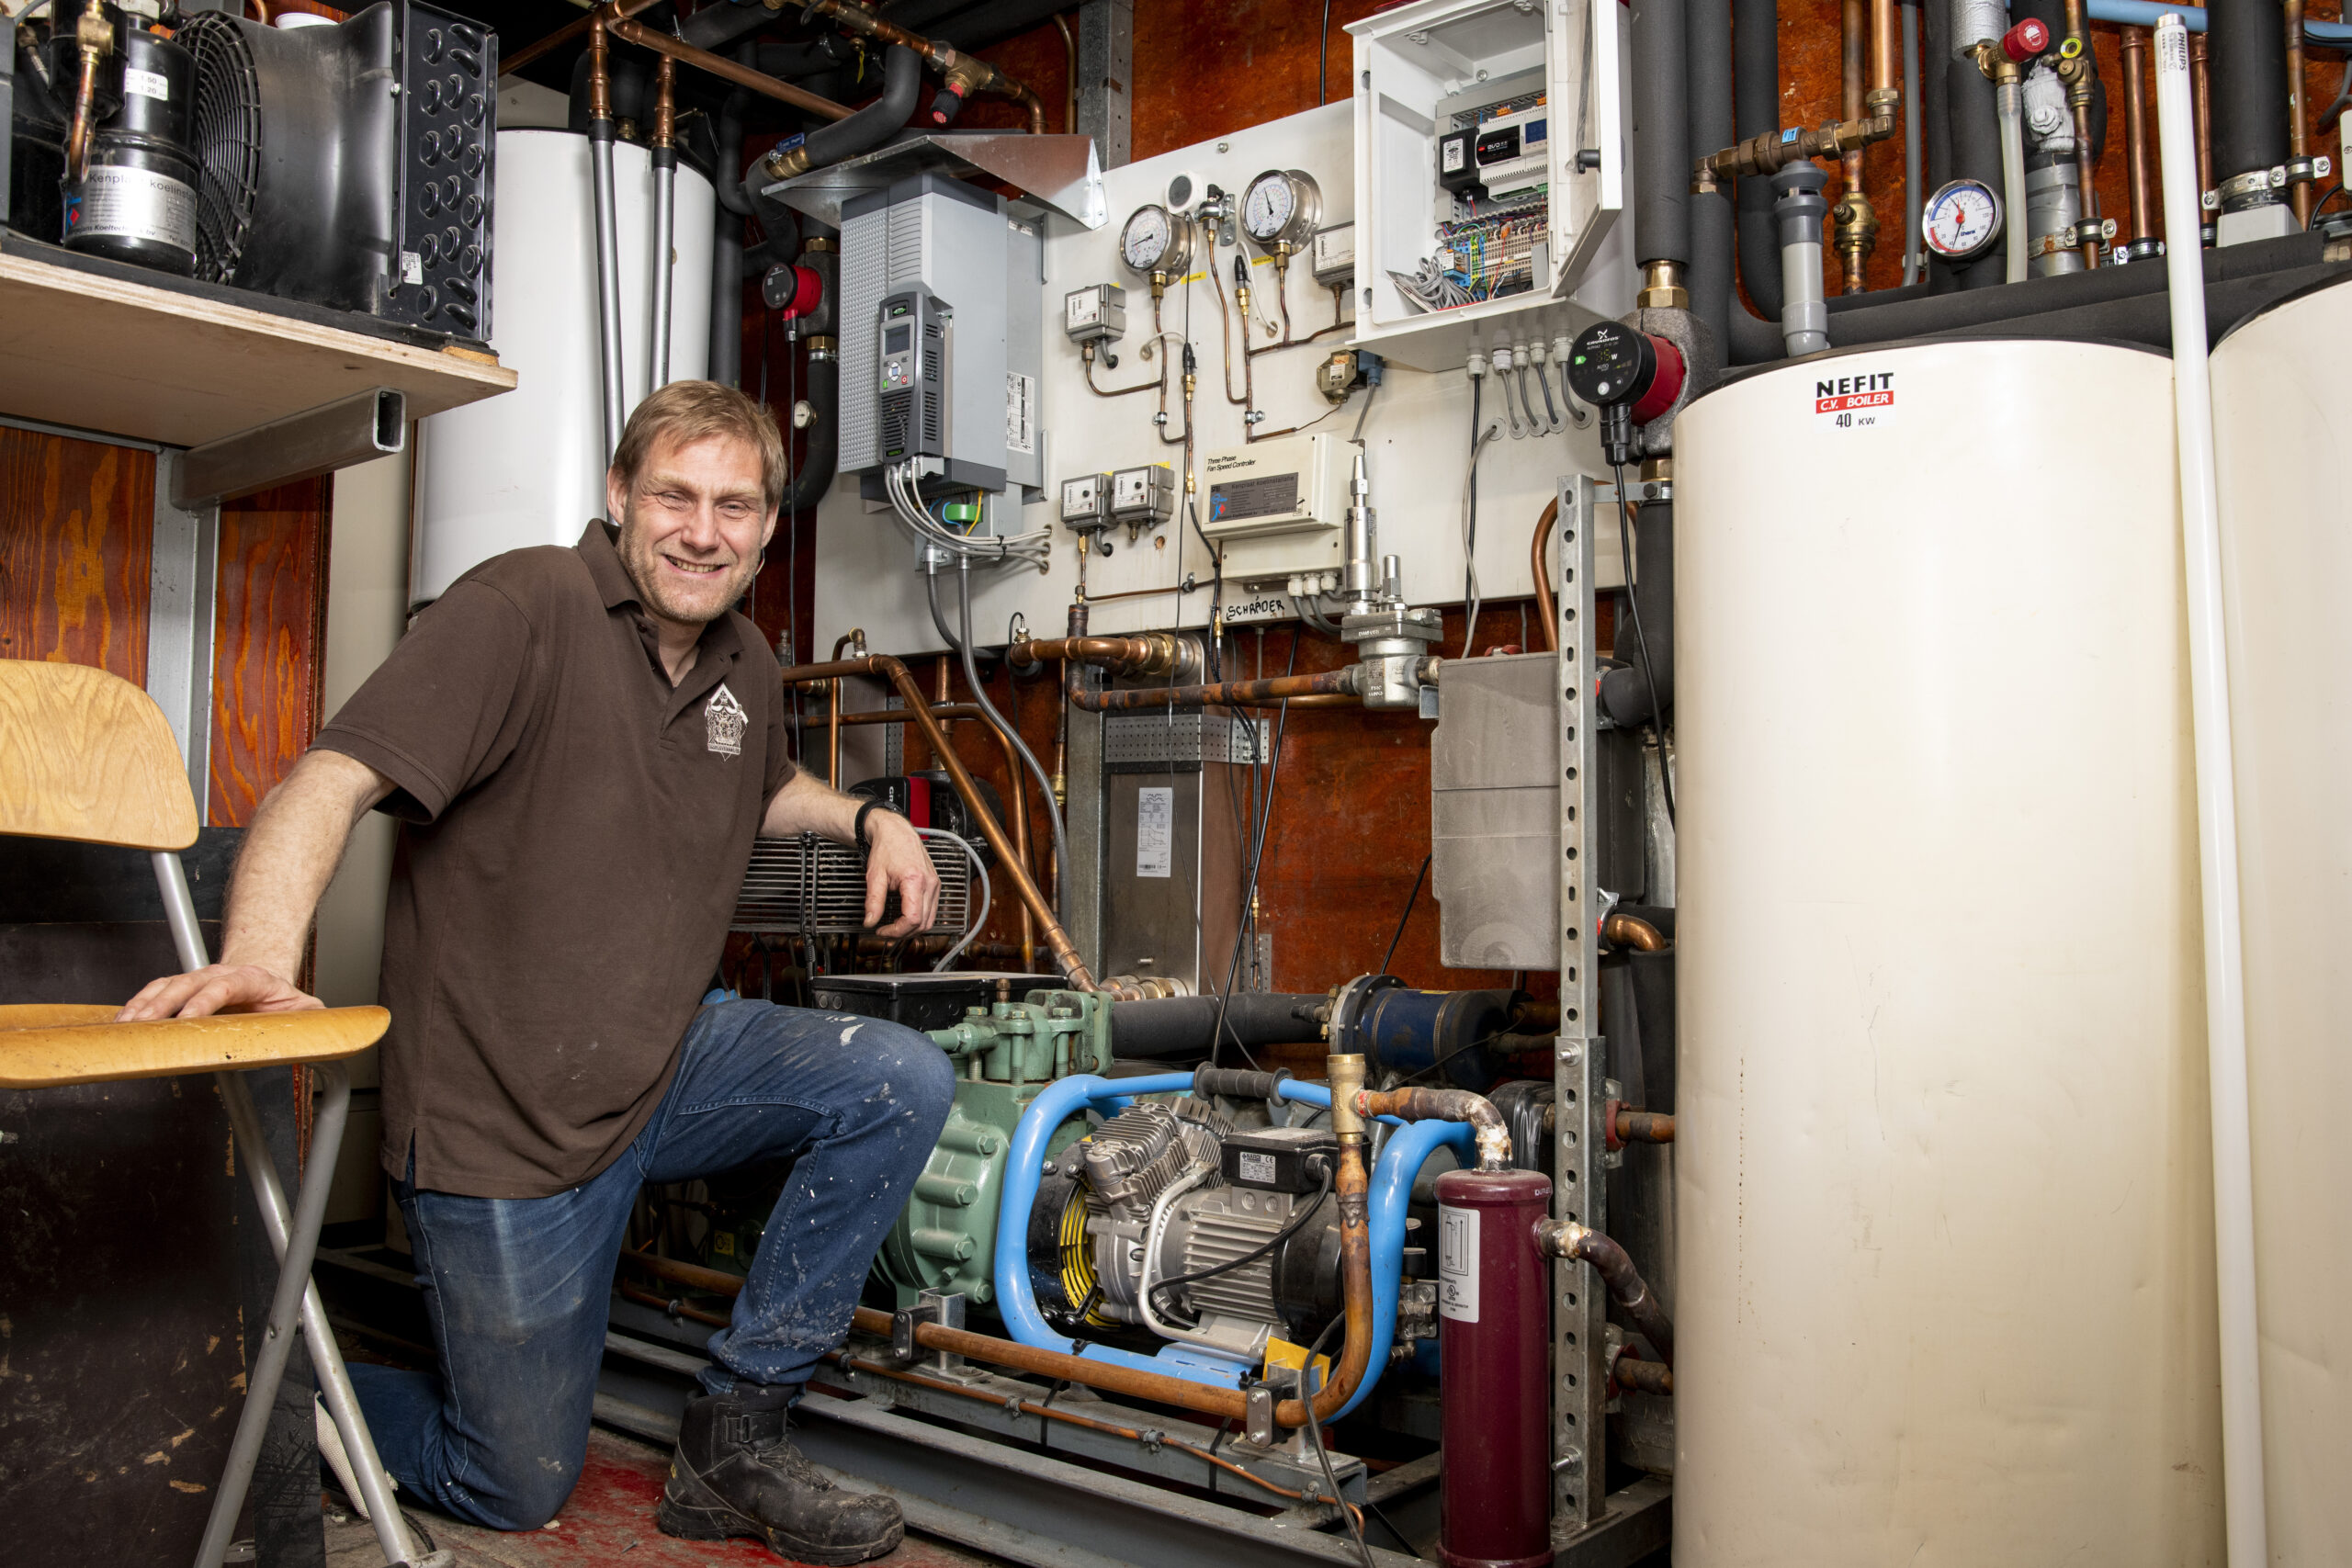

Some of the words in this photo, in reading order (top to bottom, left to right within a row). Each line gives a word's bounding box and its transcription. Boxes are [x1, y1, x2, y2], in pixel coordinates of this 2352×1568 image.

[2177, 31, 2188, 72] PHILIPS
[1587, 336, 1619, 346] GRUNDFOS
[1817, 372, 1894, 398] NEFIT
[1820, 400, 1839, 411] C.V.
[1847, 393, 1889, 408] BOILER
[1836, 412, 1851, 428] 40
[1216, 462, 1232, 471] Speed
[1232, 459, 1256, 468] Controller
